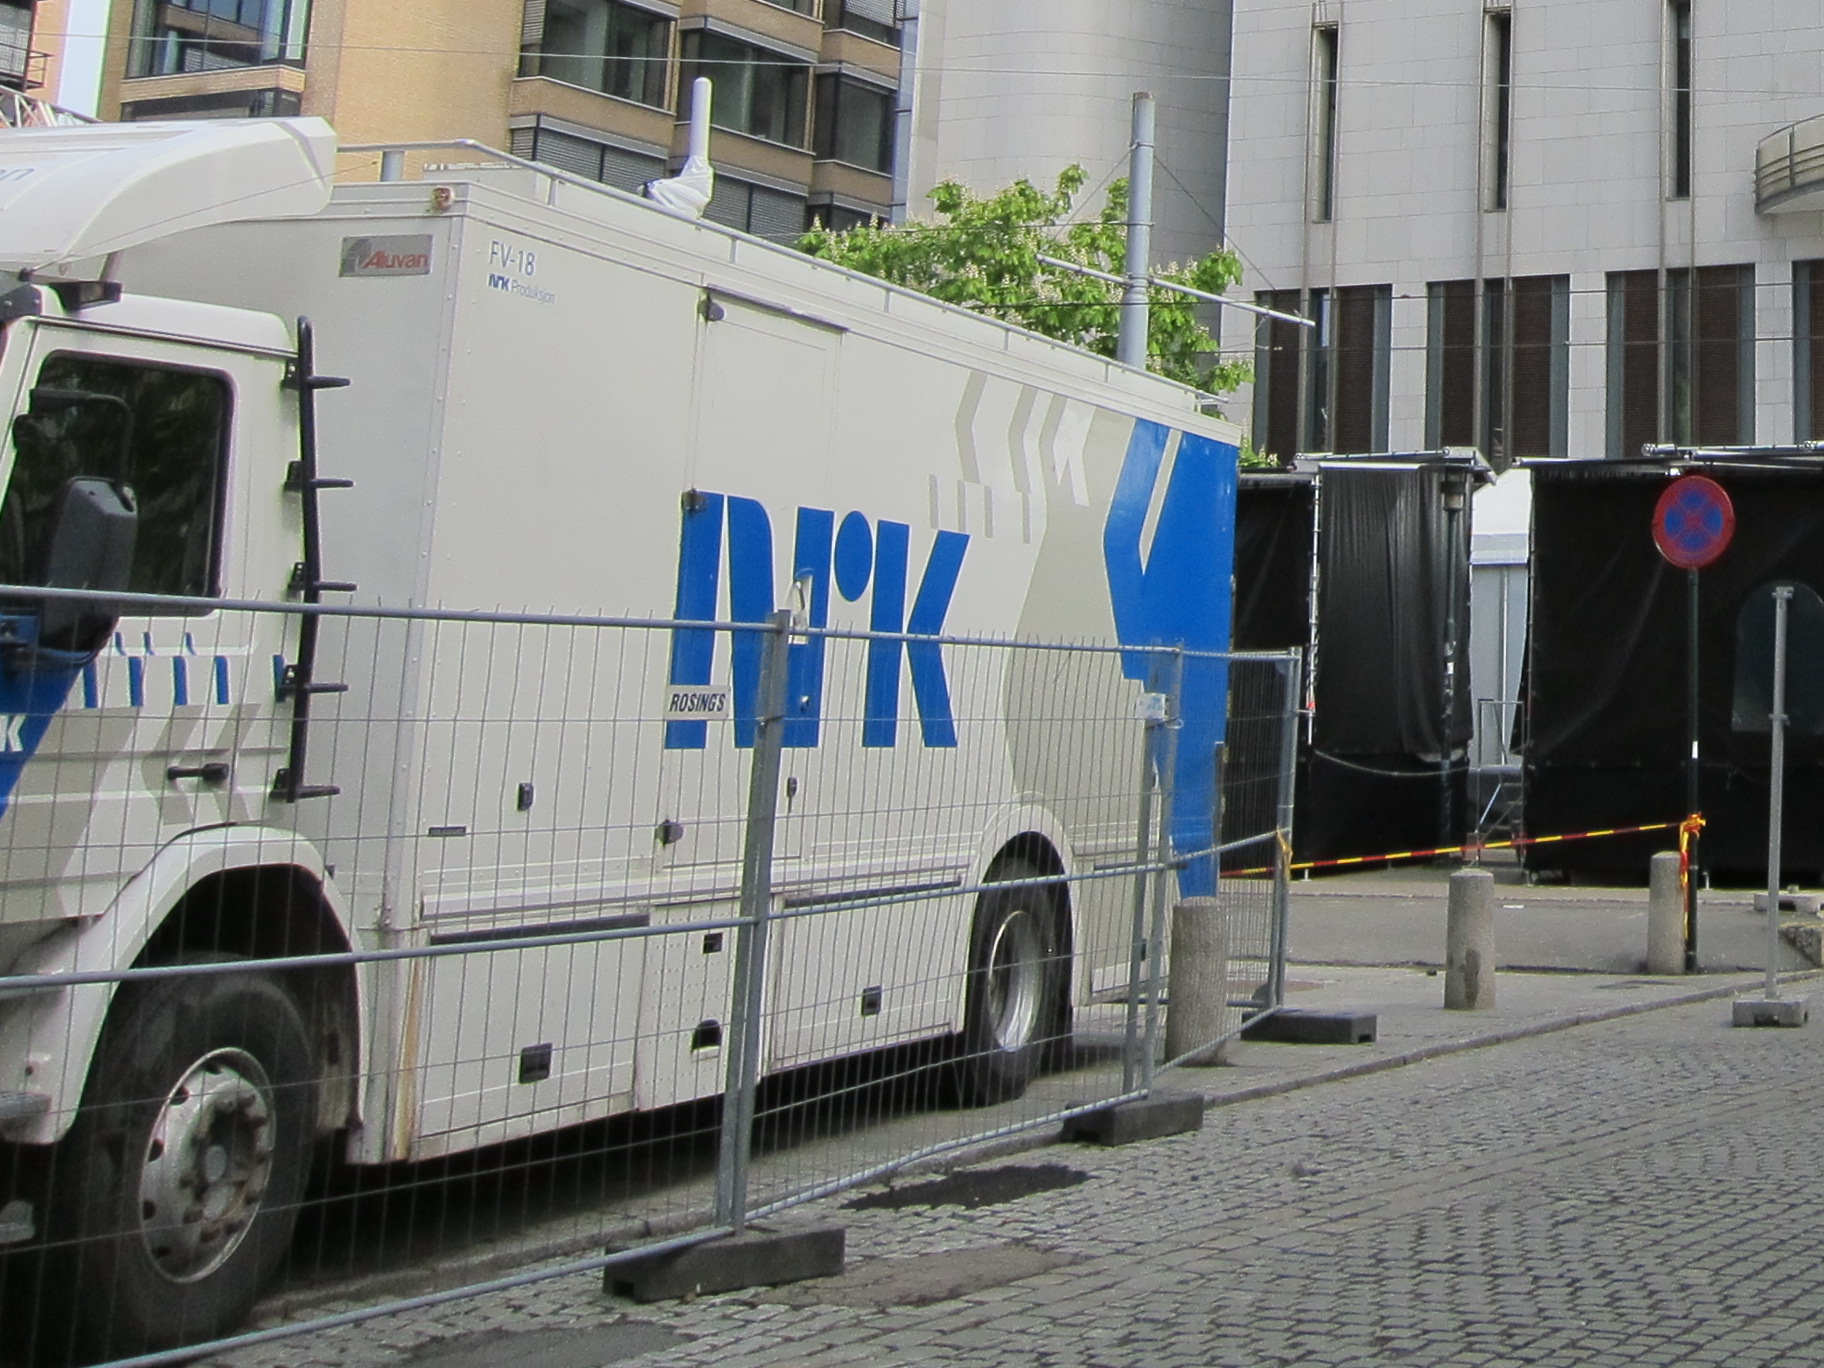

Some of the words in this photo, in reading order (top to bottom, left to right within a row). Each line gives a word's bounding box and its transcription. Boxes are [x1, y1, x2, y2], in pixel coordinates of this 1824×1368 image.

[362, 250, 428, 269] Aluvan
[490, 240, 537, 276] FV-18
[510, 279, 556, 305] Produksjon
